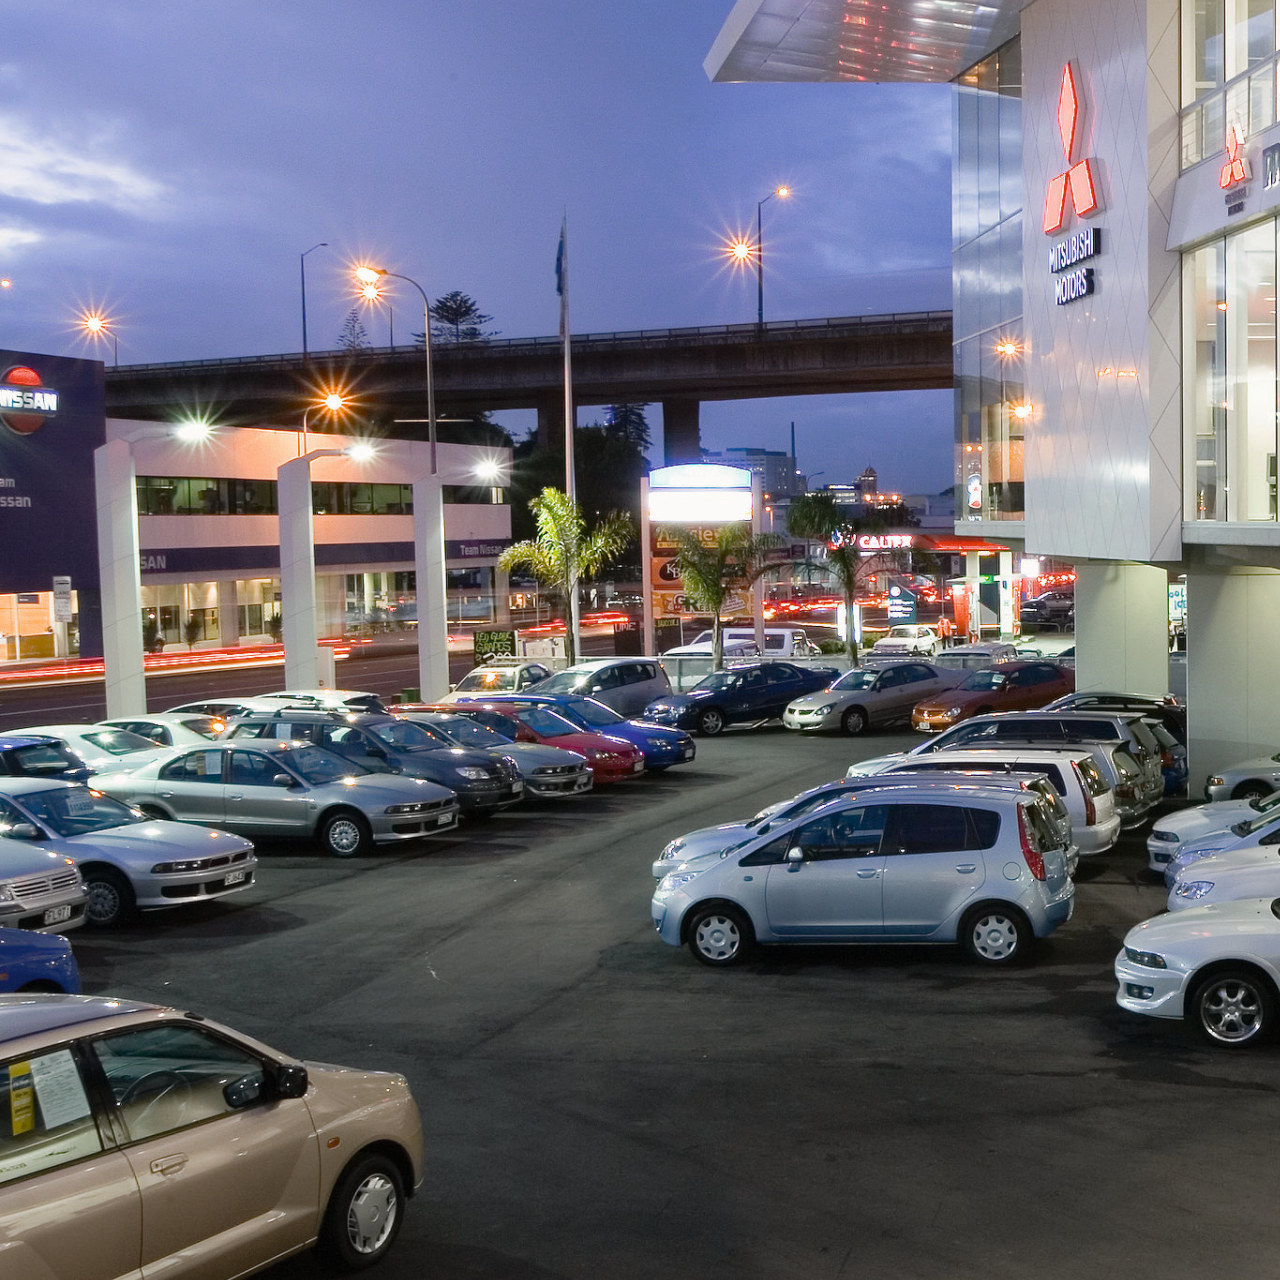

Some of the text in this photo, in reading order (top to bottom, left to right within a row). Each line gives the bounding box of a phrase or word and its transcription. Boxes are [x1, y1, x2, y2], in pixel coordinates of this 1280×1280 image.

[1049, 228, 1097, 273] MITSUBISHI
[1055, 268, 1090, 306] MOTORS
[460, 545, 479, 556] Team
